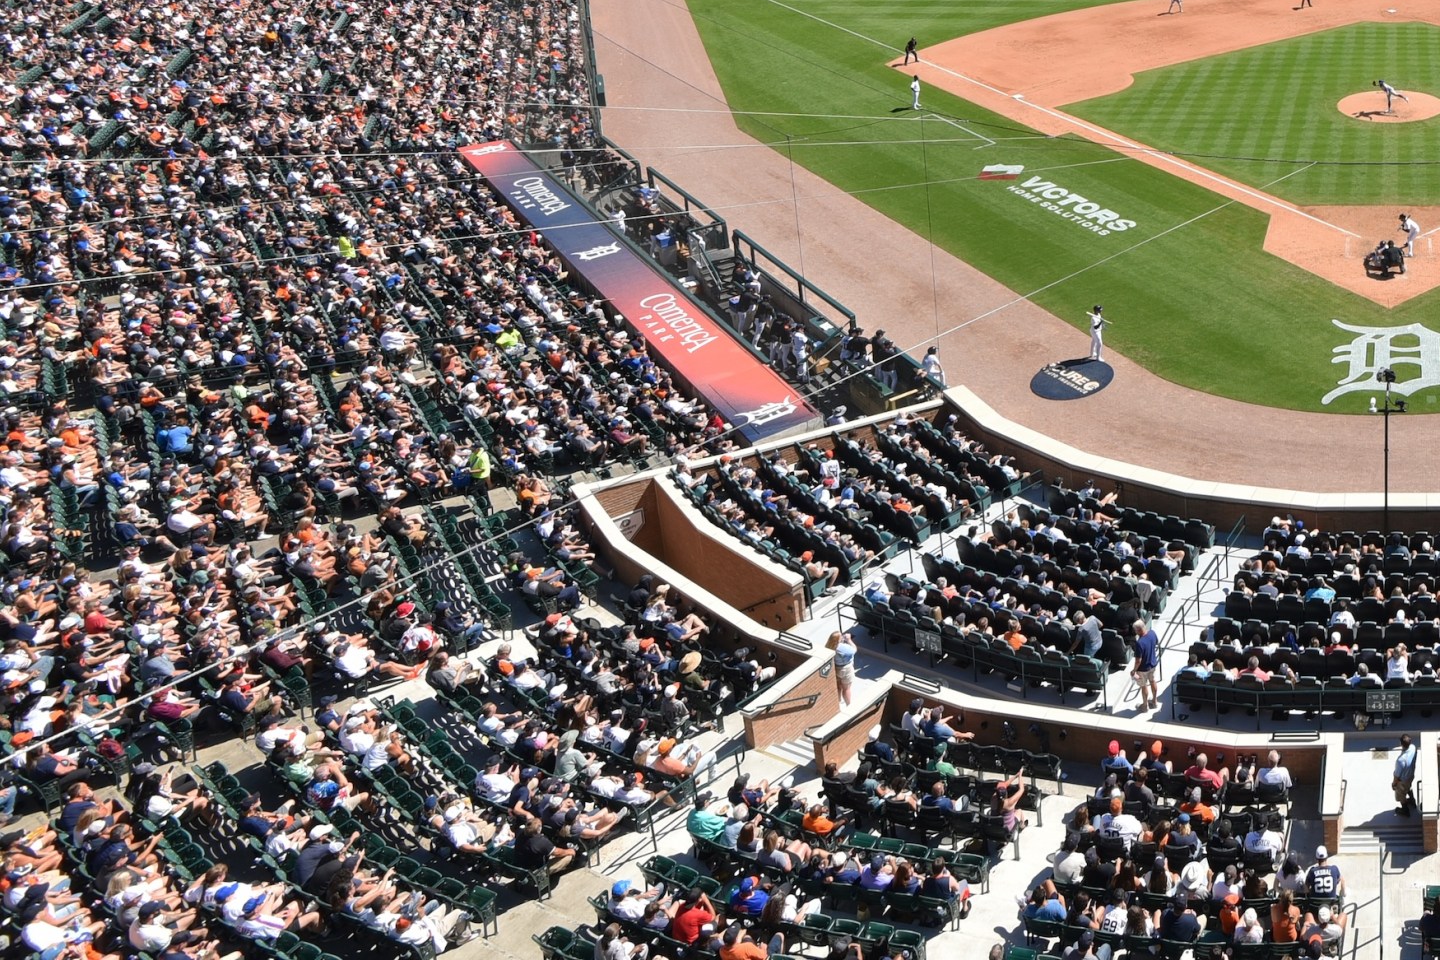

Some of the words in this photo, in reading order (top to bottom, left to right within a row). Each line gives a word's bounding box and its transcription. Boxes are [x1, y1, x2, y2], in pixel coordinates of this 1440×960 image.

[510, 191, 537, 211] PARK
[1006, 185, 1043, 204] HOME
[1040, 201, 1111, 236] SOLUTIONS
[1020, 175, 1137, 232] VICTORS
[639, 315, 676, 343] PARK
[1313, 869, 1332, 877] SKUBAL
[1314, 877, 1334, 893] 29
[1103, 918, 1117, 933] 29
